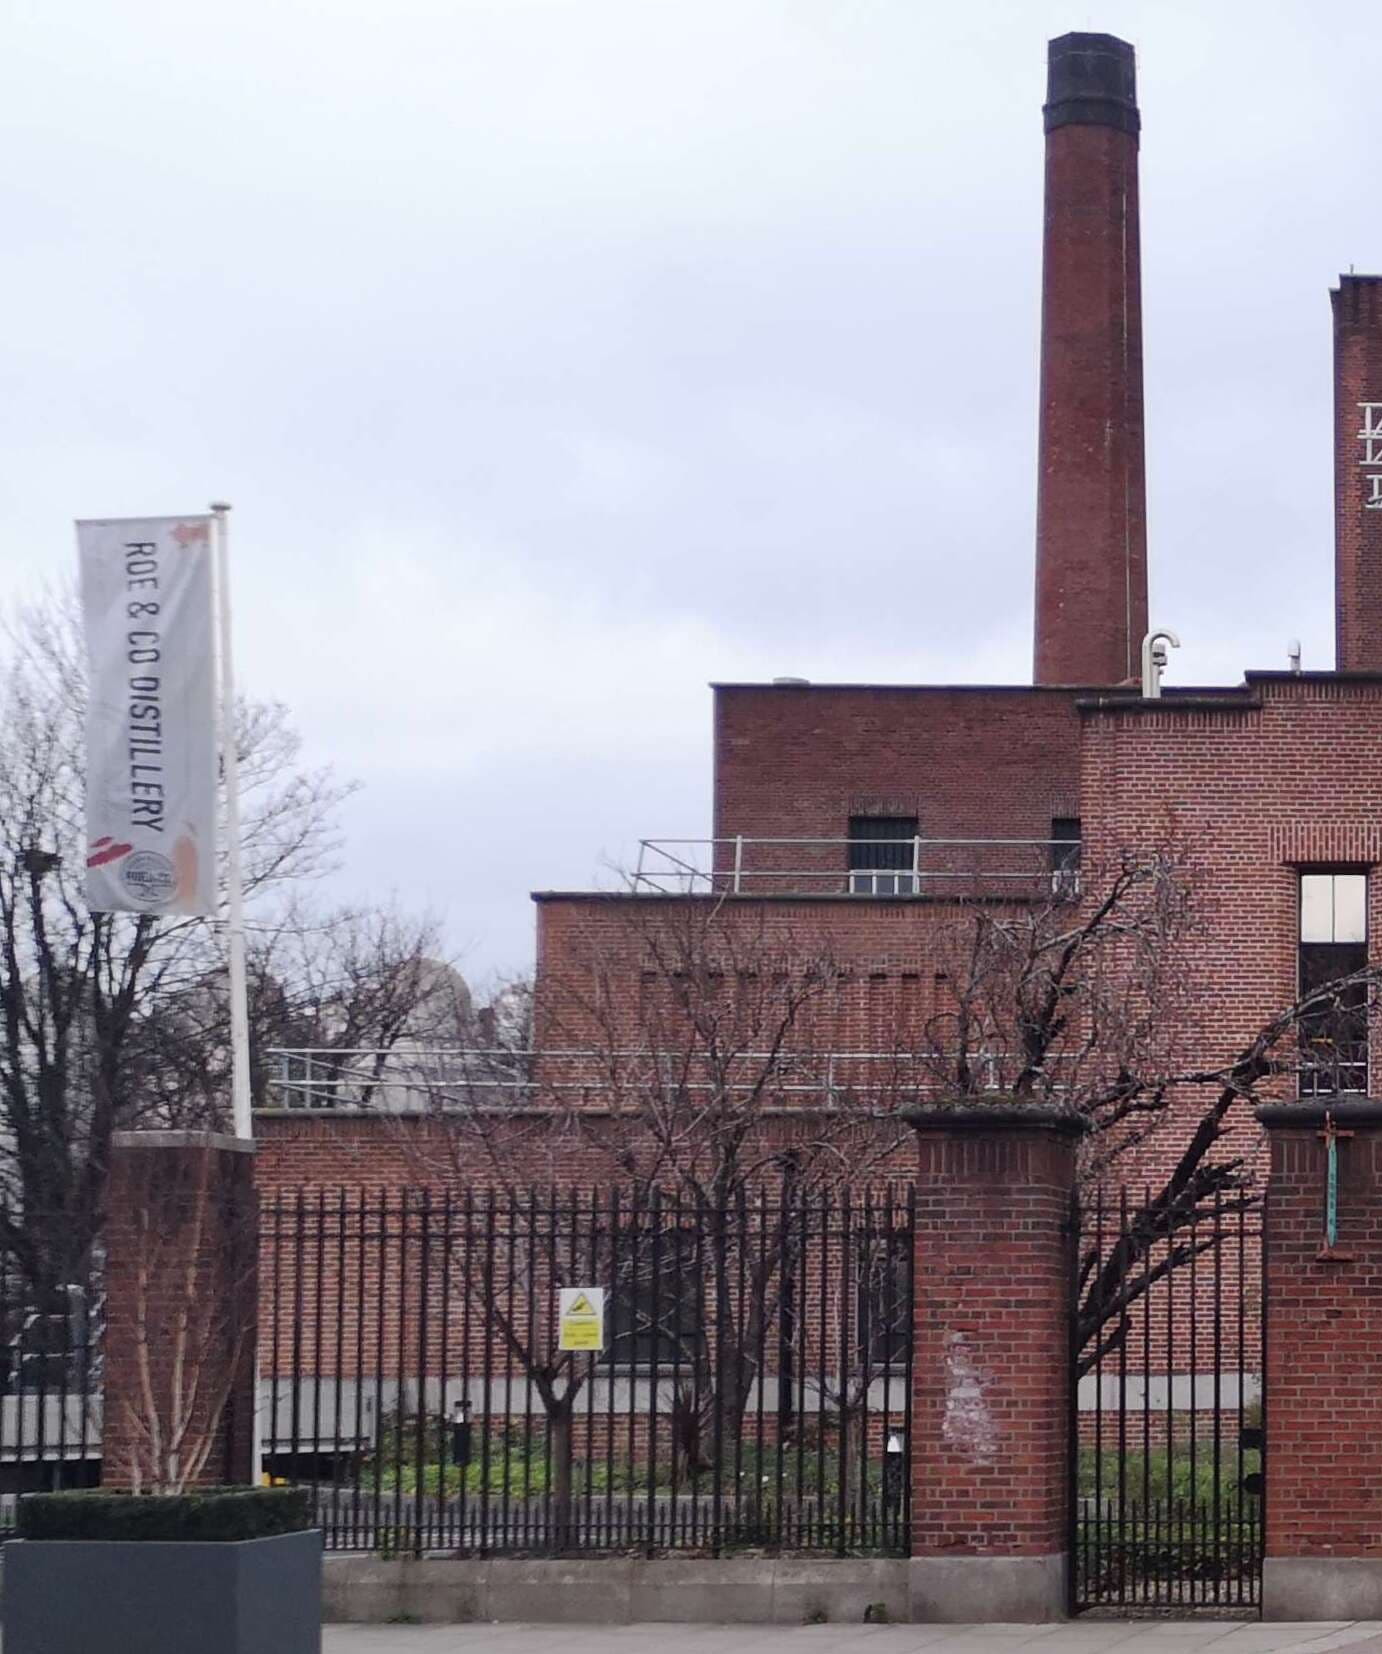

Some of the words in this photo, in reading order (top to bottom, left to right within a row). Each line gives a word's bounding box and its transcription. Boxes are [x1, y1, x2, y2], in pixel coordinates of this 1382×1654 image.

[126, 542, 158, 592] ROE
[127, 602, 160, 618] &
[127, 631, 160, 664] CO
[129, 676, 164, 833] DISTILLERY
